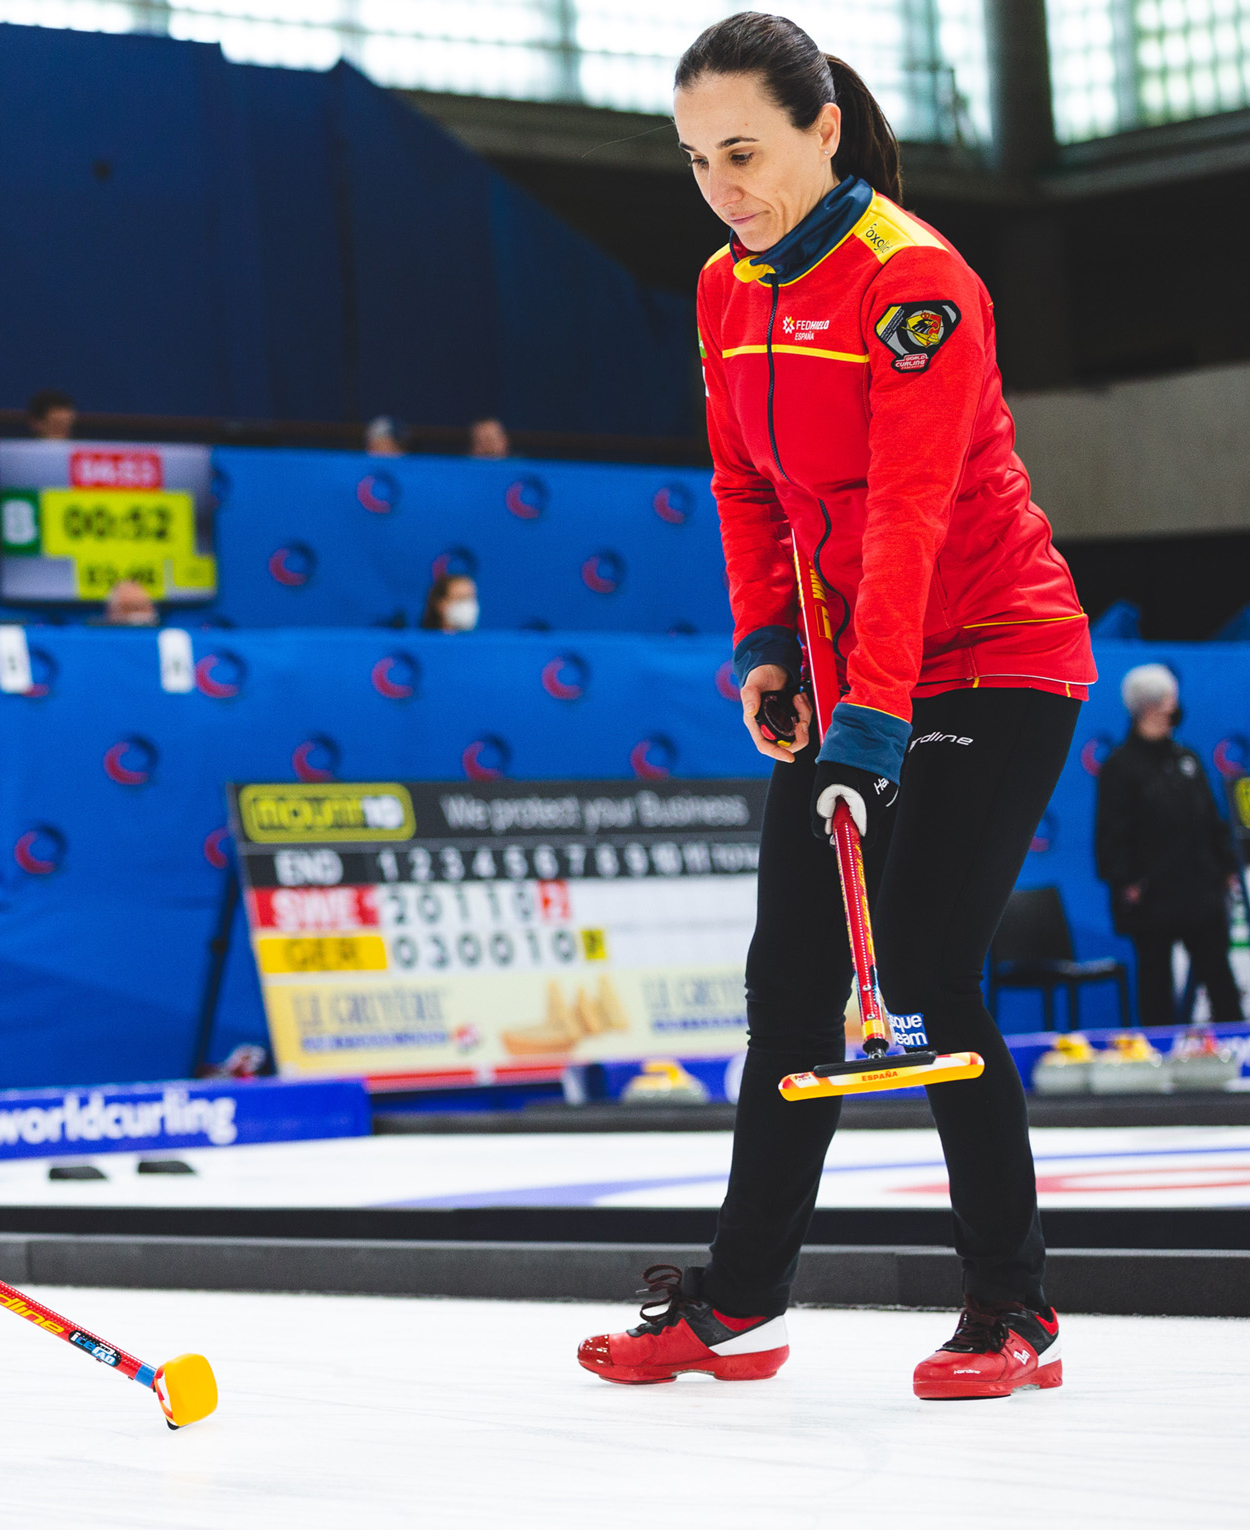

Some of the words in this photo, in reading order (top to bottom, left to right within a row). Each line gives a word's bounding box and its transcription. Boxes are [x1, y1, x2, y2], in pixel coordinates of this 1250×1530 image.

[794, 330, 815, 341] ESPAÑA
[908, 731, 974, 753] rdline
[253, 794, 405, 830] mount10
[438, 793, 489, 831] We
[488, 793, 581, 836] protect
[582, 796, 634, 836] your
[635, 790, 749, 828] Business
[273, 848, 344, 886] END
[378, 848, 399, 883] 1
[407, 847, 434, 882] 2
[440, 846, 465, 881] 3
[471, 846, 497, 880] 4
[503, 844, 529, 880] 5
[533, 843, 560, 879] 6
[563, 843, 586, 877] 7
[594, 842, 620, 877] 8
[623, 841, 649, 877] 9
[651, 840, 683, 876] 10
[682, 840, 712, 875] 11
[272, 887, 354, 932] SWE
[416, 890, 443, 924] 0
[282, 937, 362, 969] GER
[392, 934, 419, 969] 0
[456, 931, 483, 967] 0
[489, 930, 515, 966] 0
[551, 928, 577, 963] 0
[894, 1032, 928, 1046] eam
[861, 1071, 899, 1082] ESPAÑA
